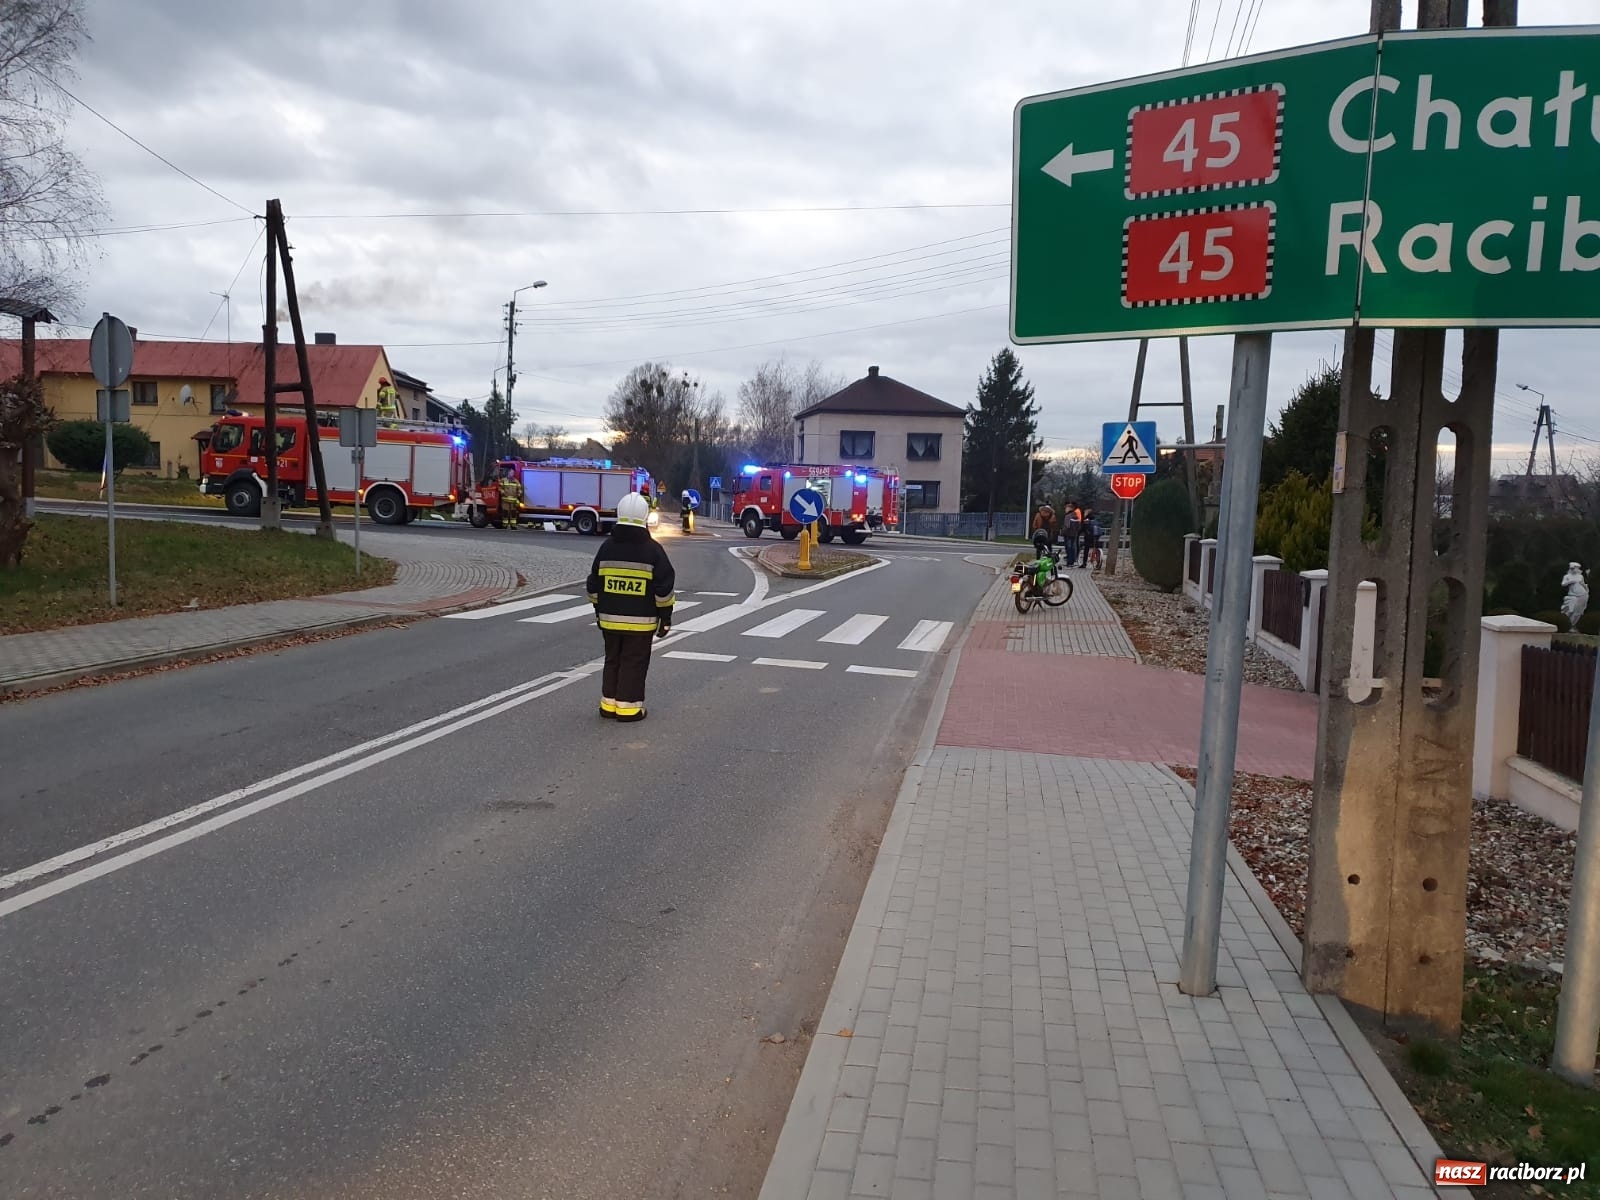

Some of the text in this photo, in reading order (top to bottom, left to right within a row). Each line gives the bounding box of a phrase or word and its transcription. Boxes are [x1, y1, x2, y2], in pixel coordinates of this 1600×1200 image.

[1163, 70, 1600, 173] 45 Chał
[1159, 195, 1600, 284] 45 Racib
[1115, 476, 1142, 488] STOP
